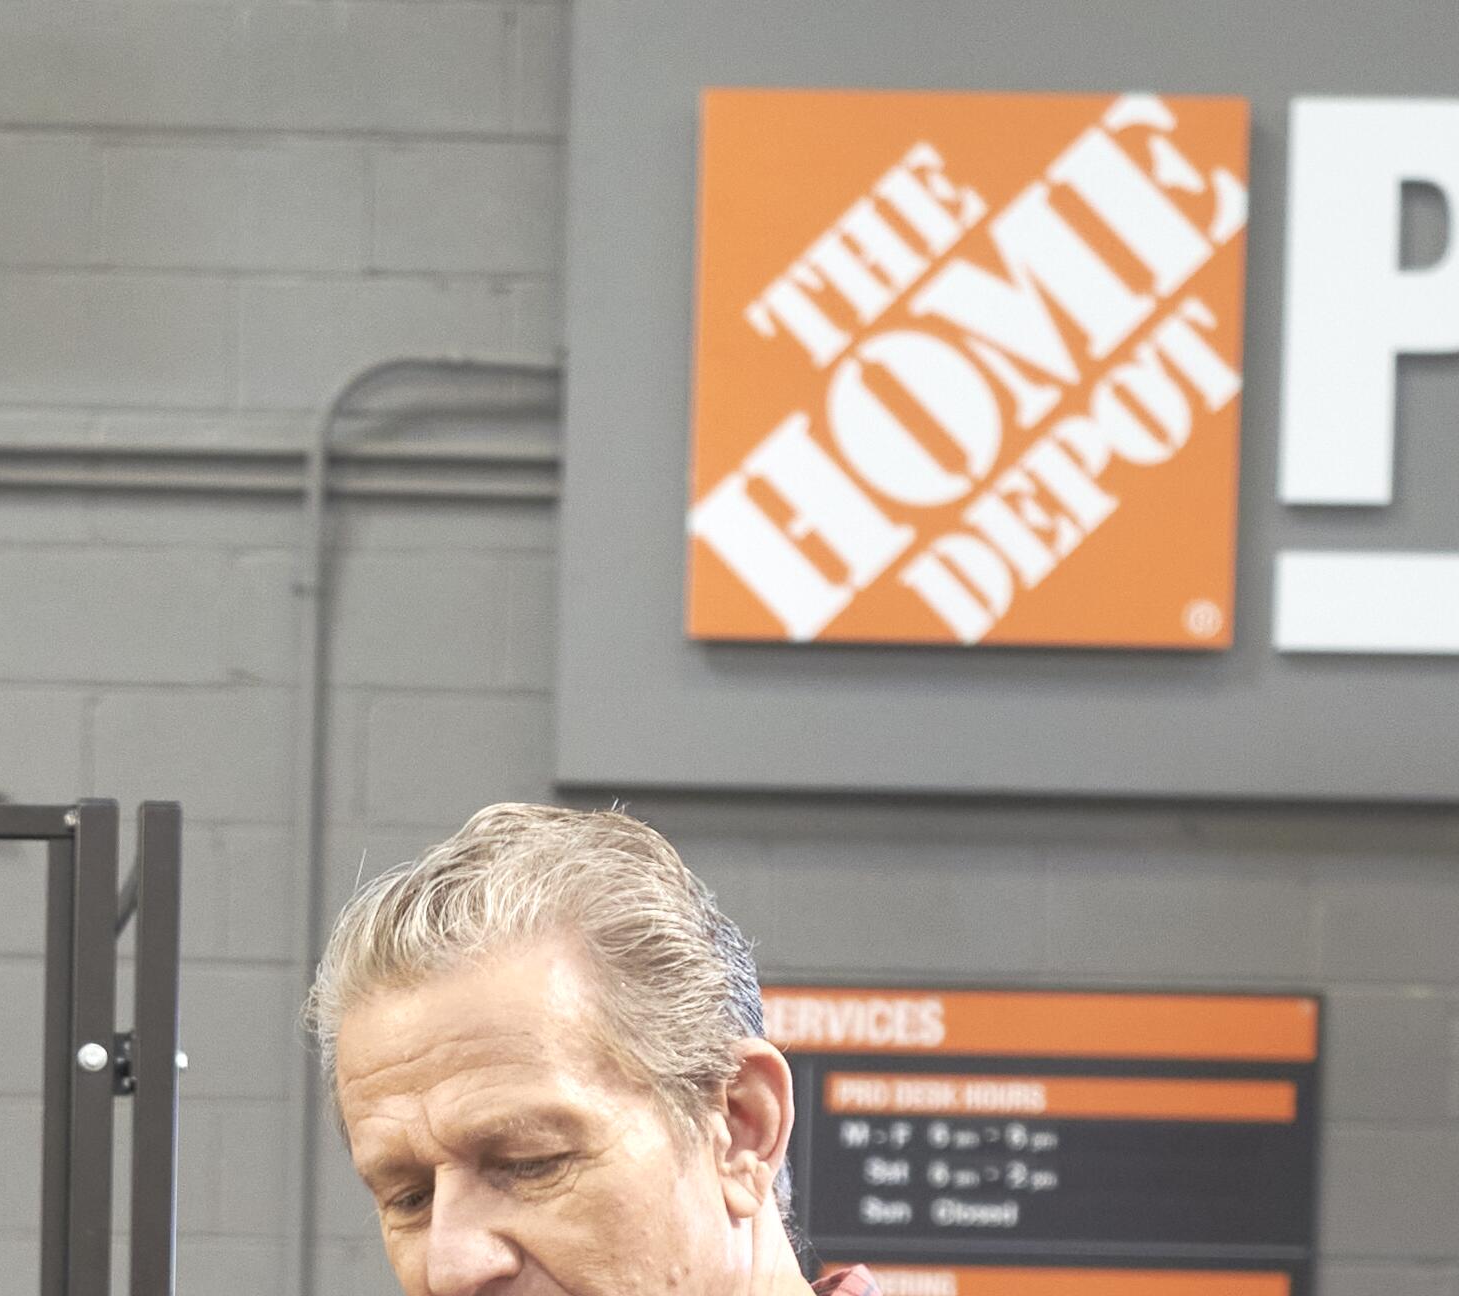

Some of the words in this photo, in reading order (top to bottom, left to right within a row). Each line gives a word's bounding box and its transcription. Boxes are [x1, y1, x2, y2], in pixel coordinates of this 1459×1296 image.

[686, 90, 1249, 643] HOME
[743, 140, 987, 369] THE
[897, 296, 1243, 644] DEPOT
